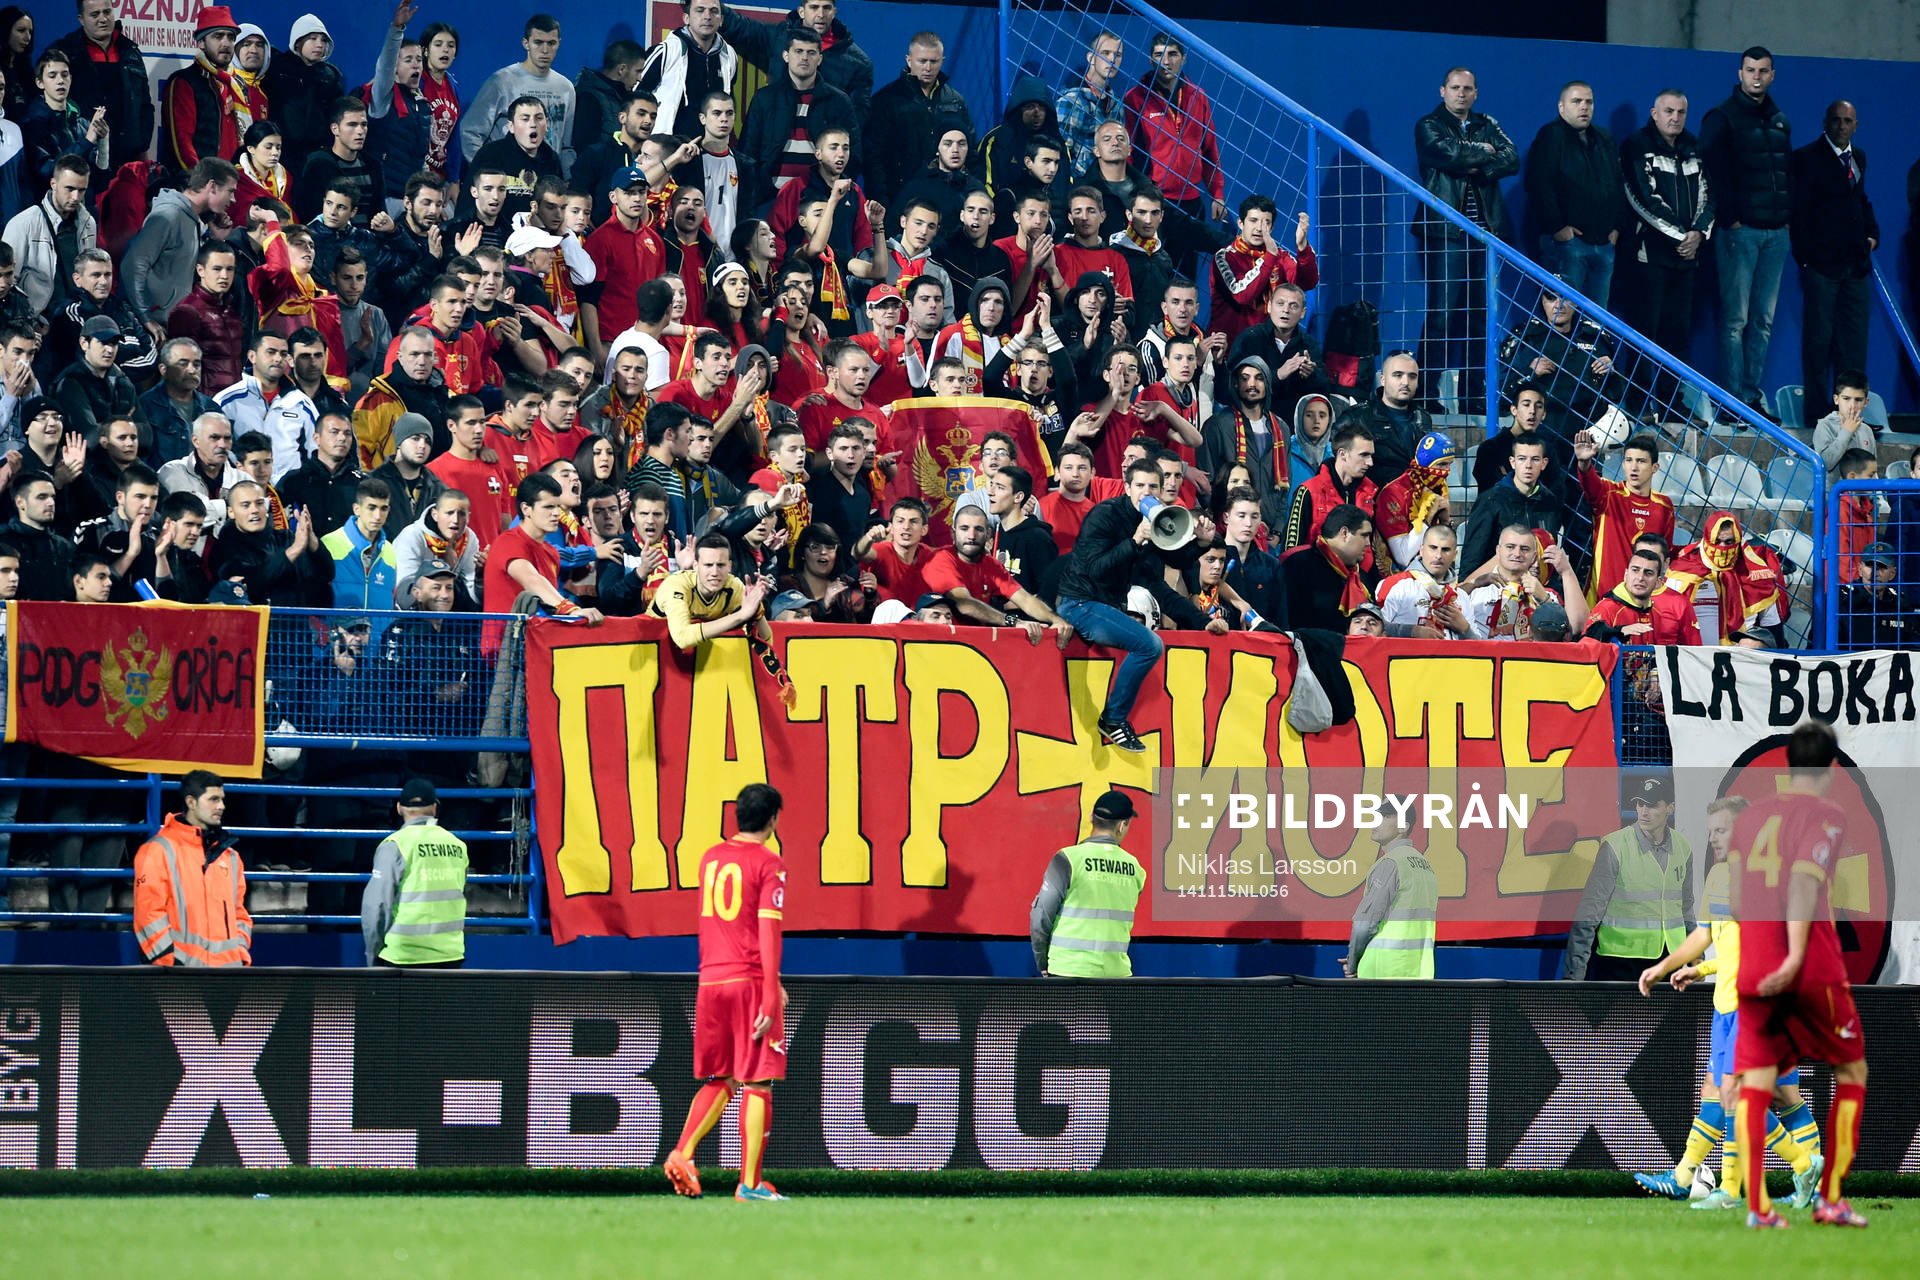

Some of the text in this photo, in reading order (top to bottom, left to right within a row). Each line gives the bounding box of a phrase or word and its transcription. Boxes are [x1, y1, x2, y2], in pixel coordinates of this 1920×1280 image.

[157, 27, 165, 46] SE
[167, 28, 176, 48] NA
[1423, 436, 1435, 450] 9
[1666, 646, 1915, 727] LA BOKA
[418, 843, 463, 859] STEWARD
[1747, 815, 1783, 887] 4
[1085, 857, 1135, 877] STEWARD
[701, 860, 743, 922] 10
